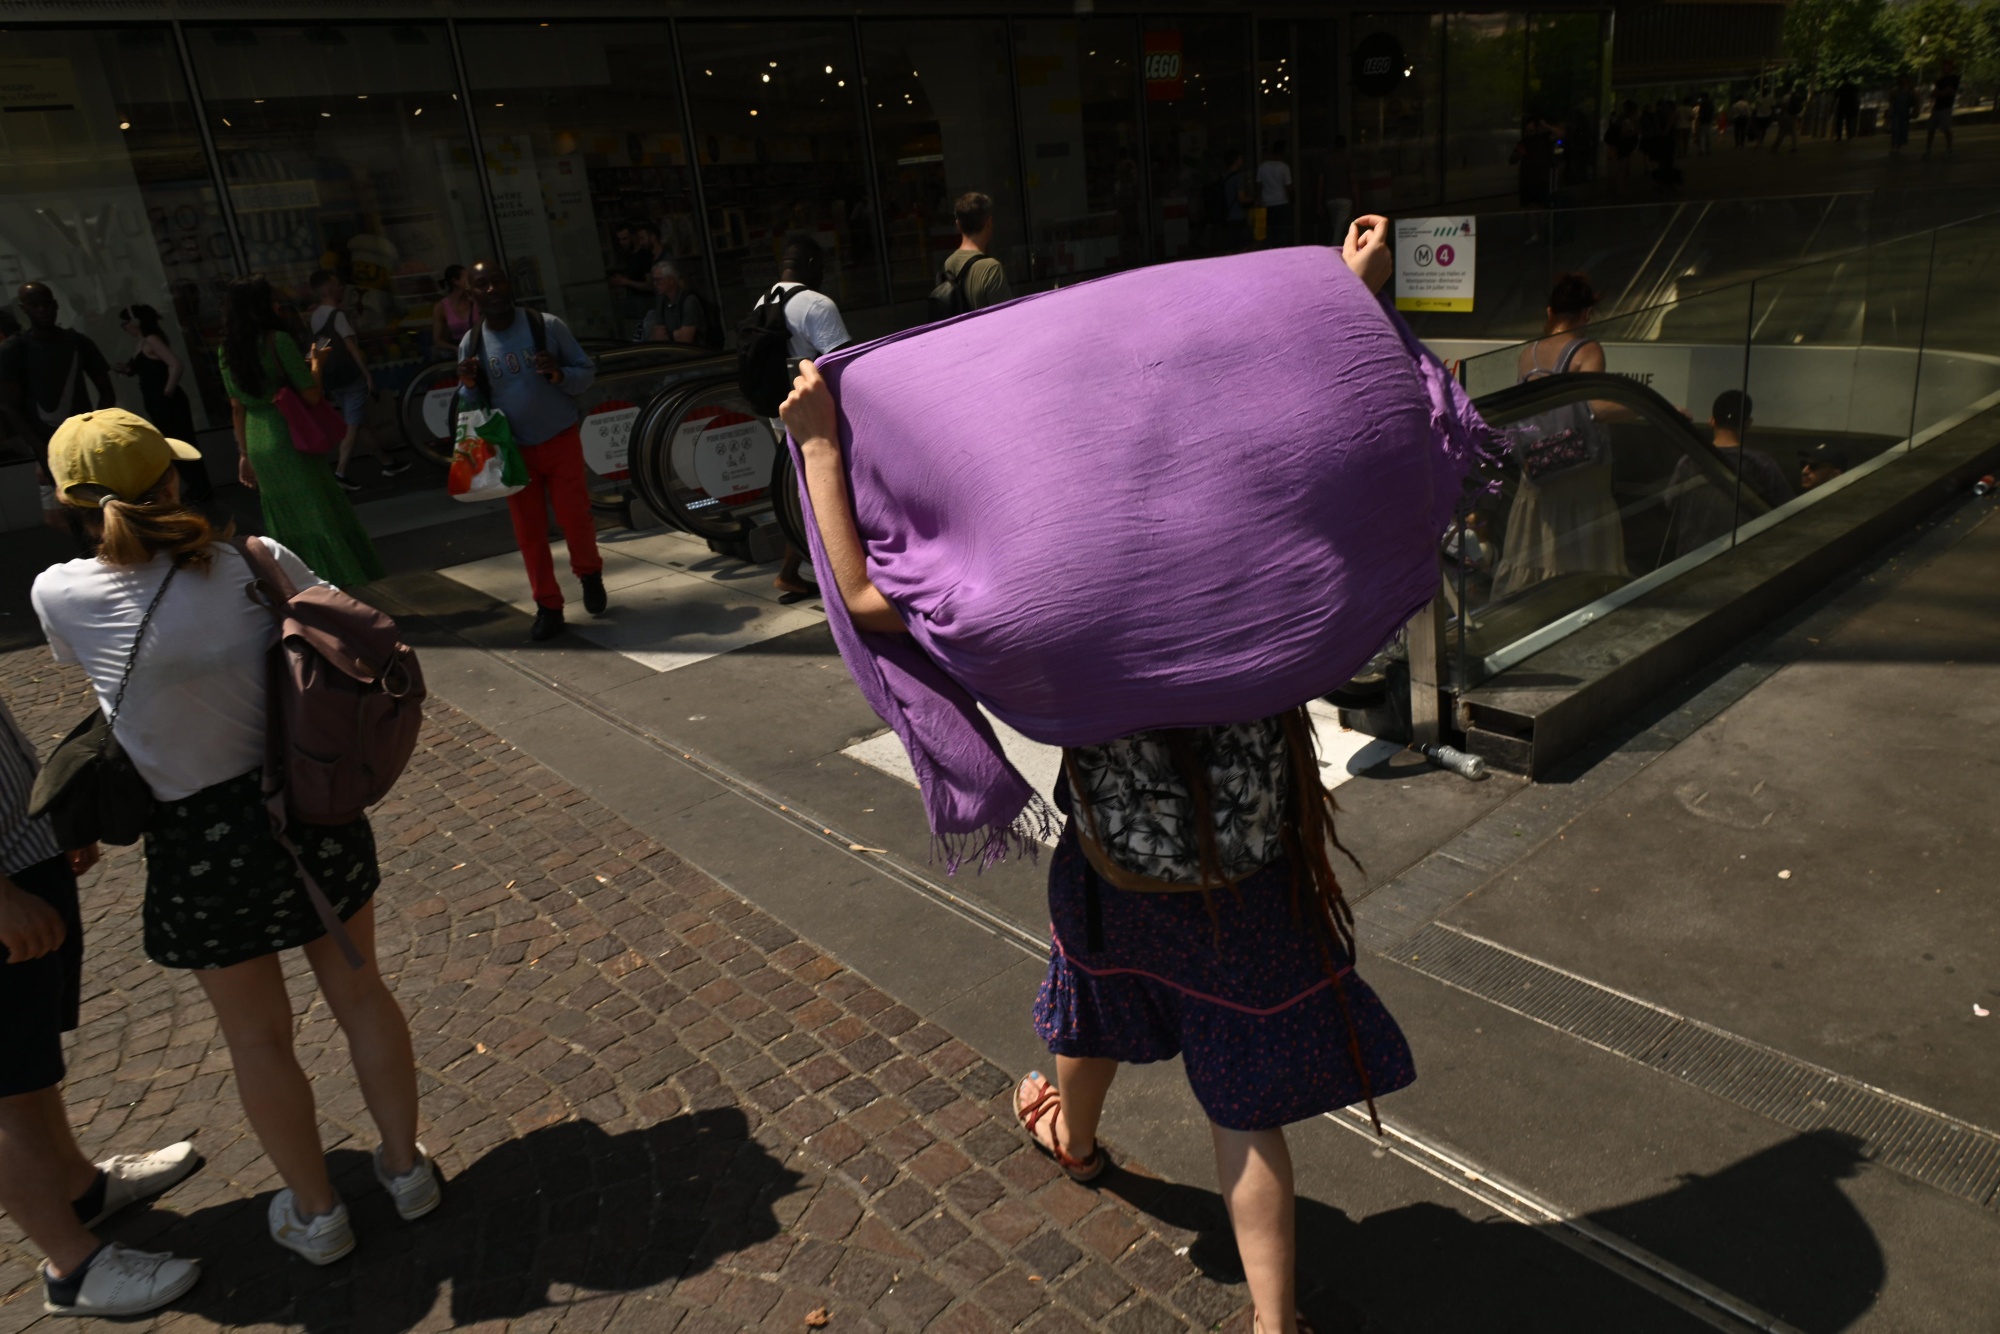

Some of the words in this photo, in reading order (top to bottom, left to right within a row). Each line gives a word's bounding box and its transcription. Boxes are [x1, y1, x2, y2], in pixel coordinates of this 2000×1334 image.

[1144, 54, 1180, 79] LEGO
[1363, 56, 1391, 75] LEGO
[1418, 249, 1429, 262] M
[1440, 249, 1450, 262] 4
